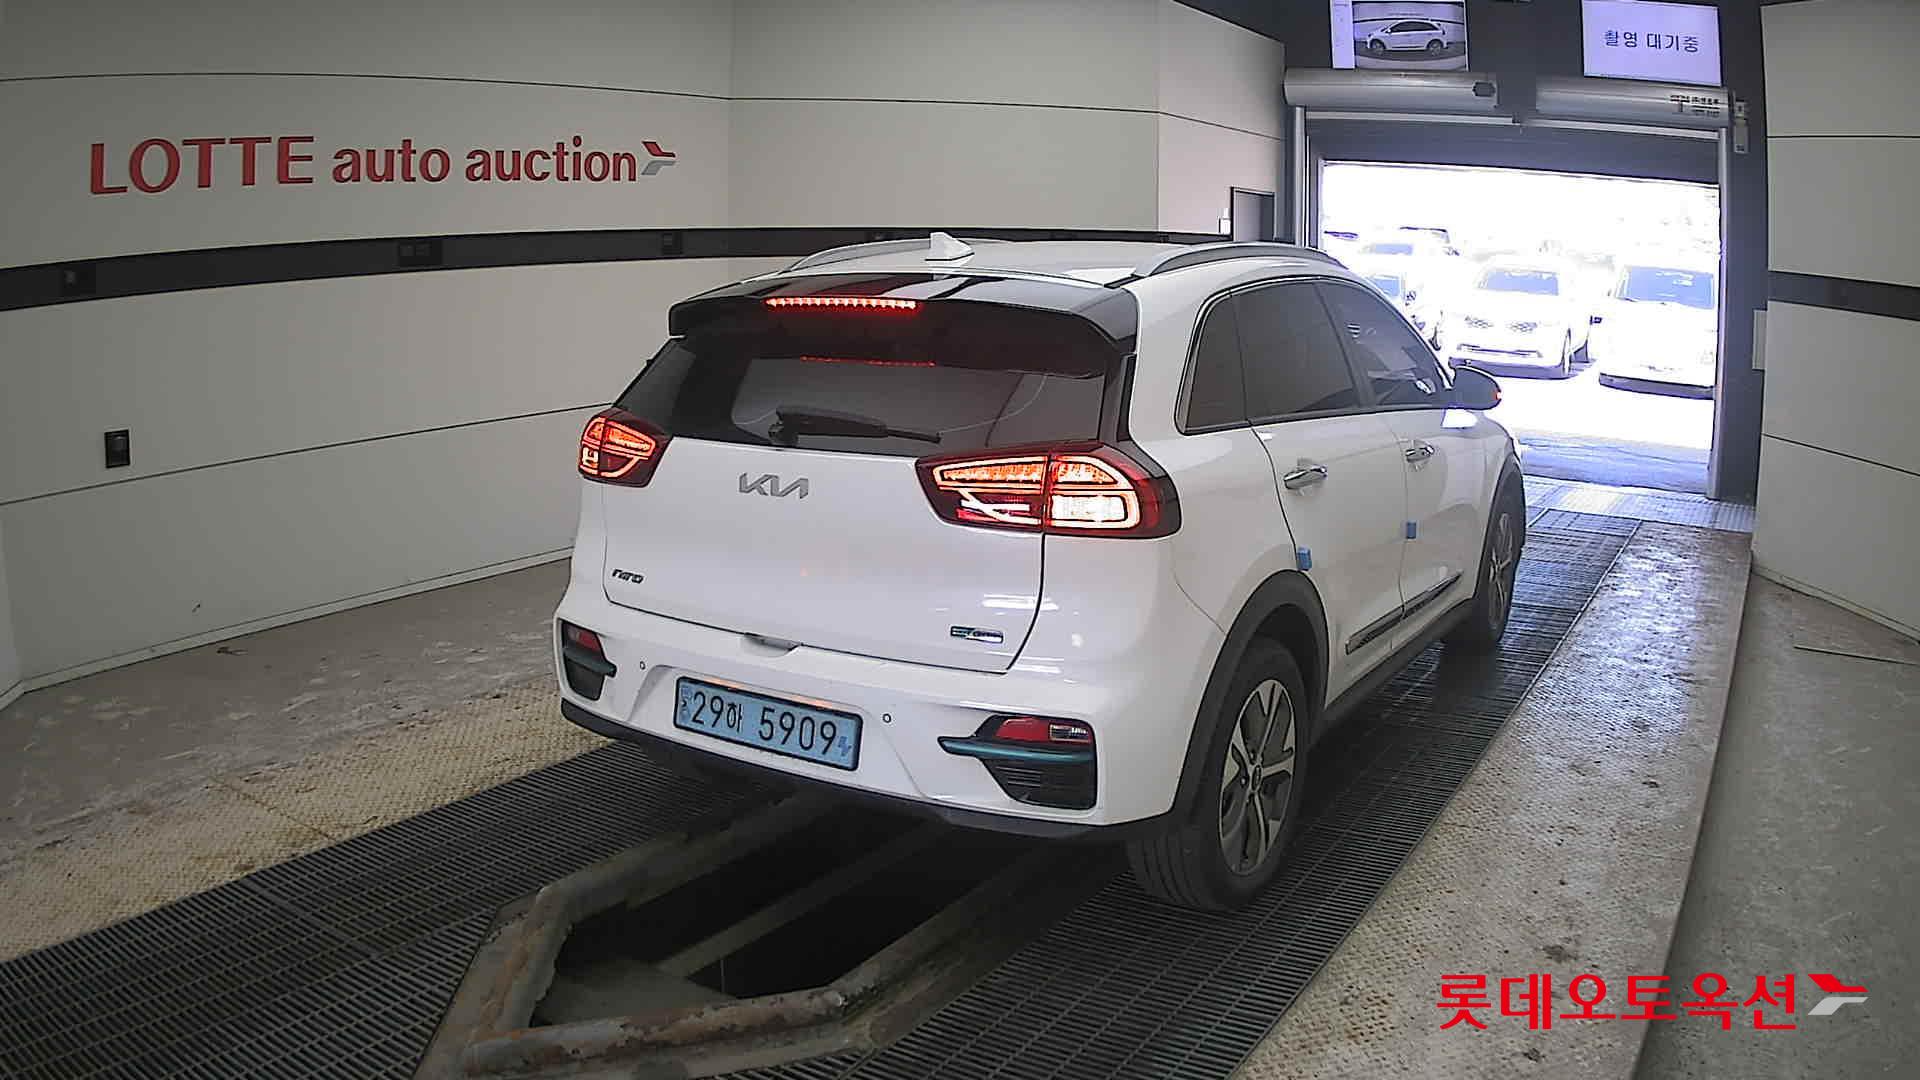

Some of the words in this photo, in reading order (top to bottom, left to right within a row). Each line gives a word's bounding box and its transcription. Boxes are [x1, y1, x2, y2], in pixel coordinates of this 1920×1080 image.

[1646, 33, 1699, 53] 대기중
[90, 136, 315, 195] LOTTE
[332, 138, 451, 183] auto
[465, 135, 637, 183] auction
[738, 472, 809, 500] KIA
[691, 691, 744, 733] 29하
[758, 706, 838, 756] 5909
